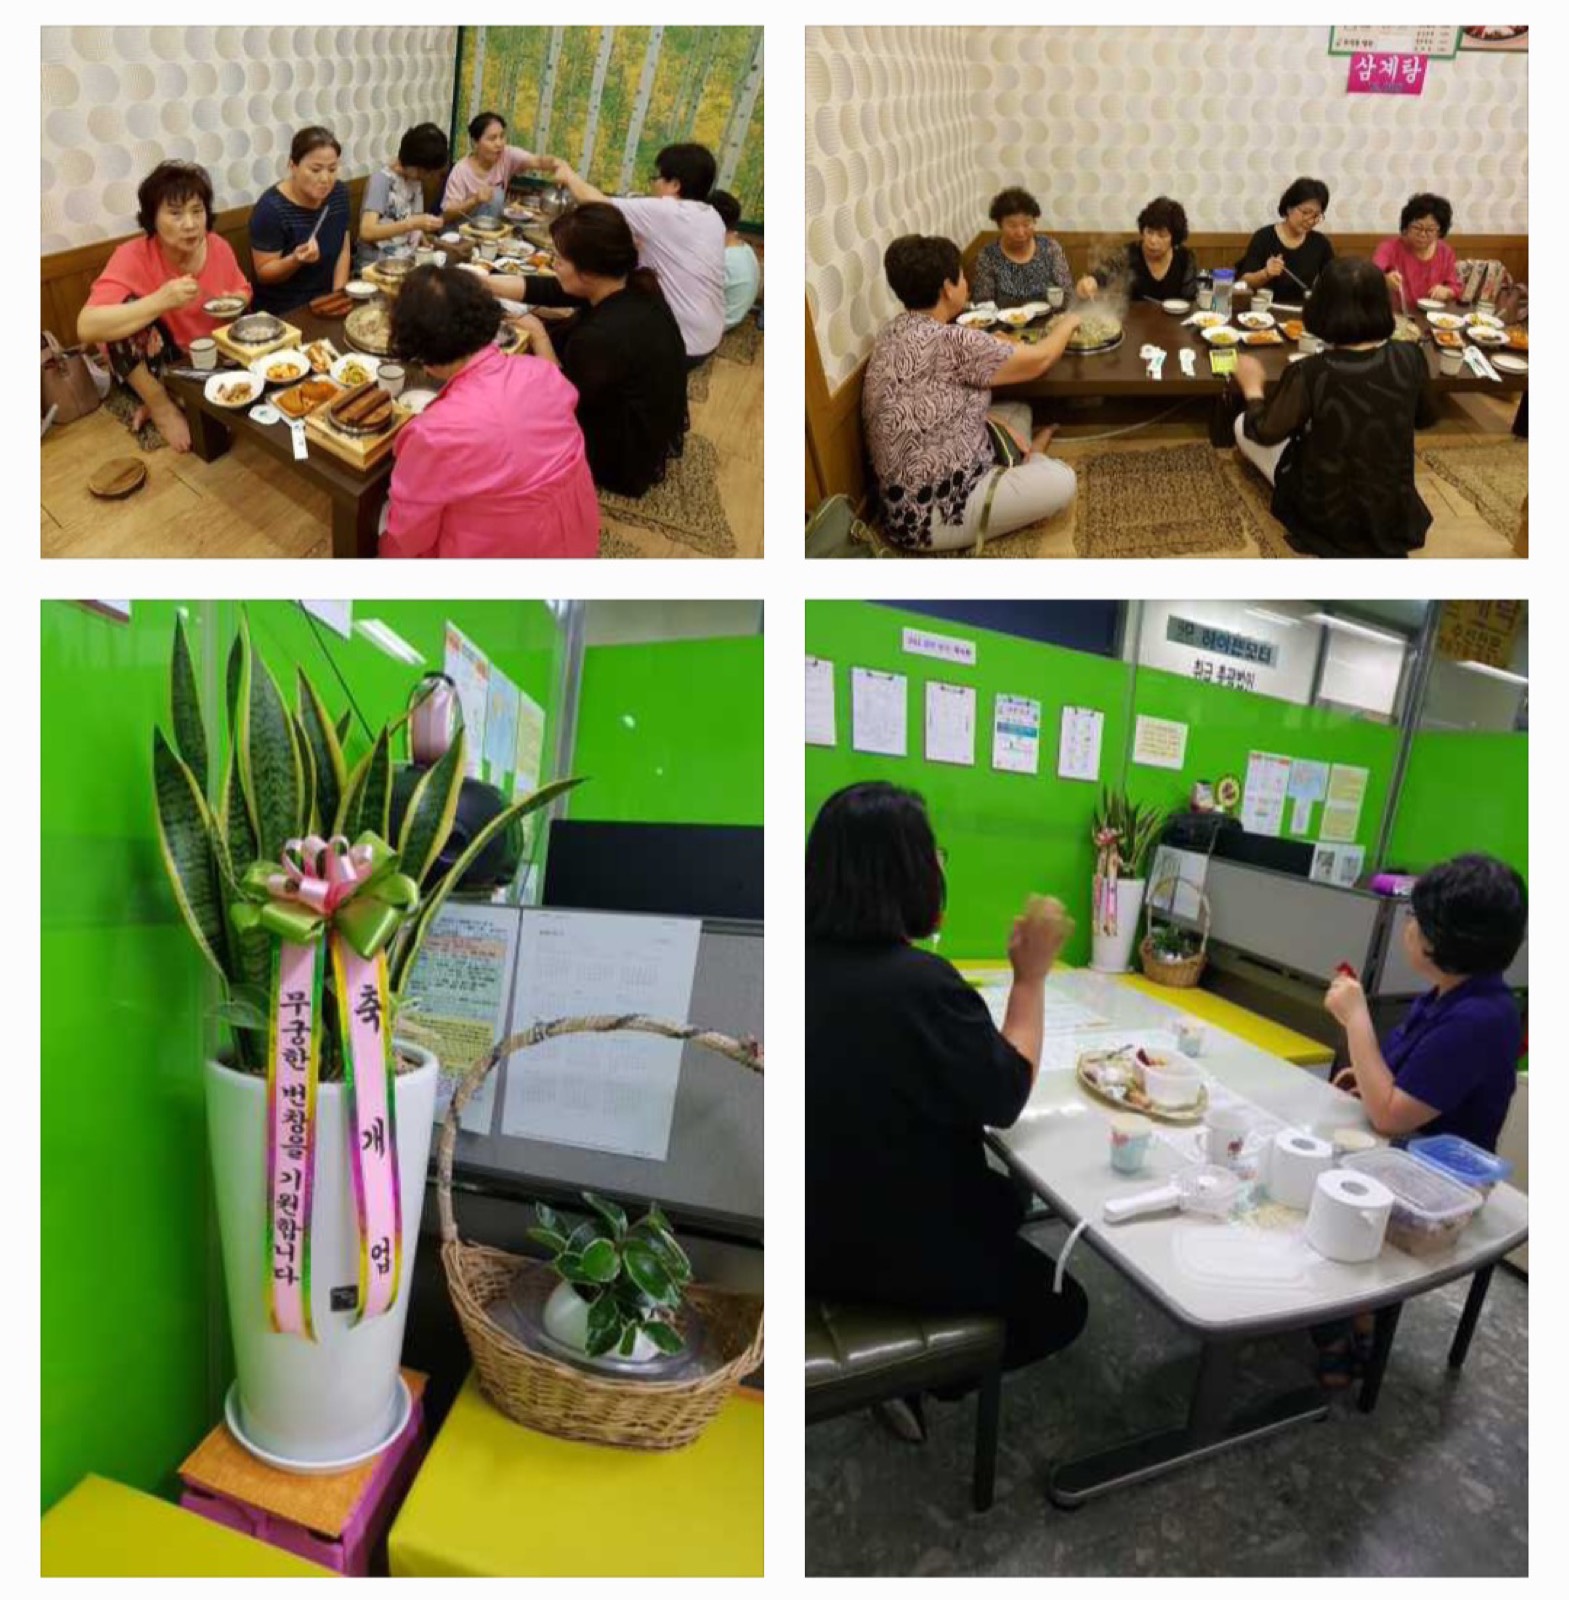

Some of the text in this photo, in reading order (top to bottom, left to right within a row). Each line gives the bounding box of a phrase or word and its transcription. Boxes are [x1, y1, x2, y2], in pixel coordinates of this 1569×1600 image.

[1355, 53, 1422, 84] 삼계탕
[274, 990, 311, 1286] 무궁한 번창을 기원합니다
[355, 984, 390, 1276] 축 개 업
